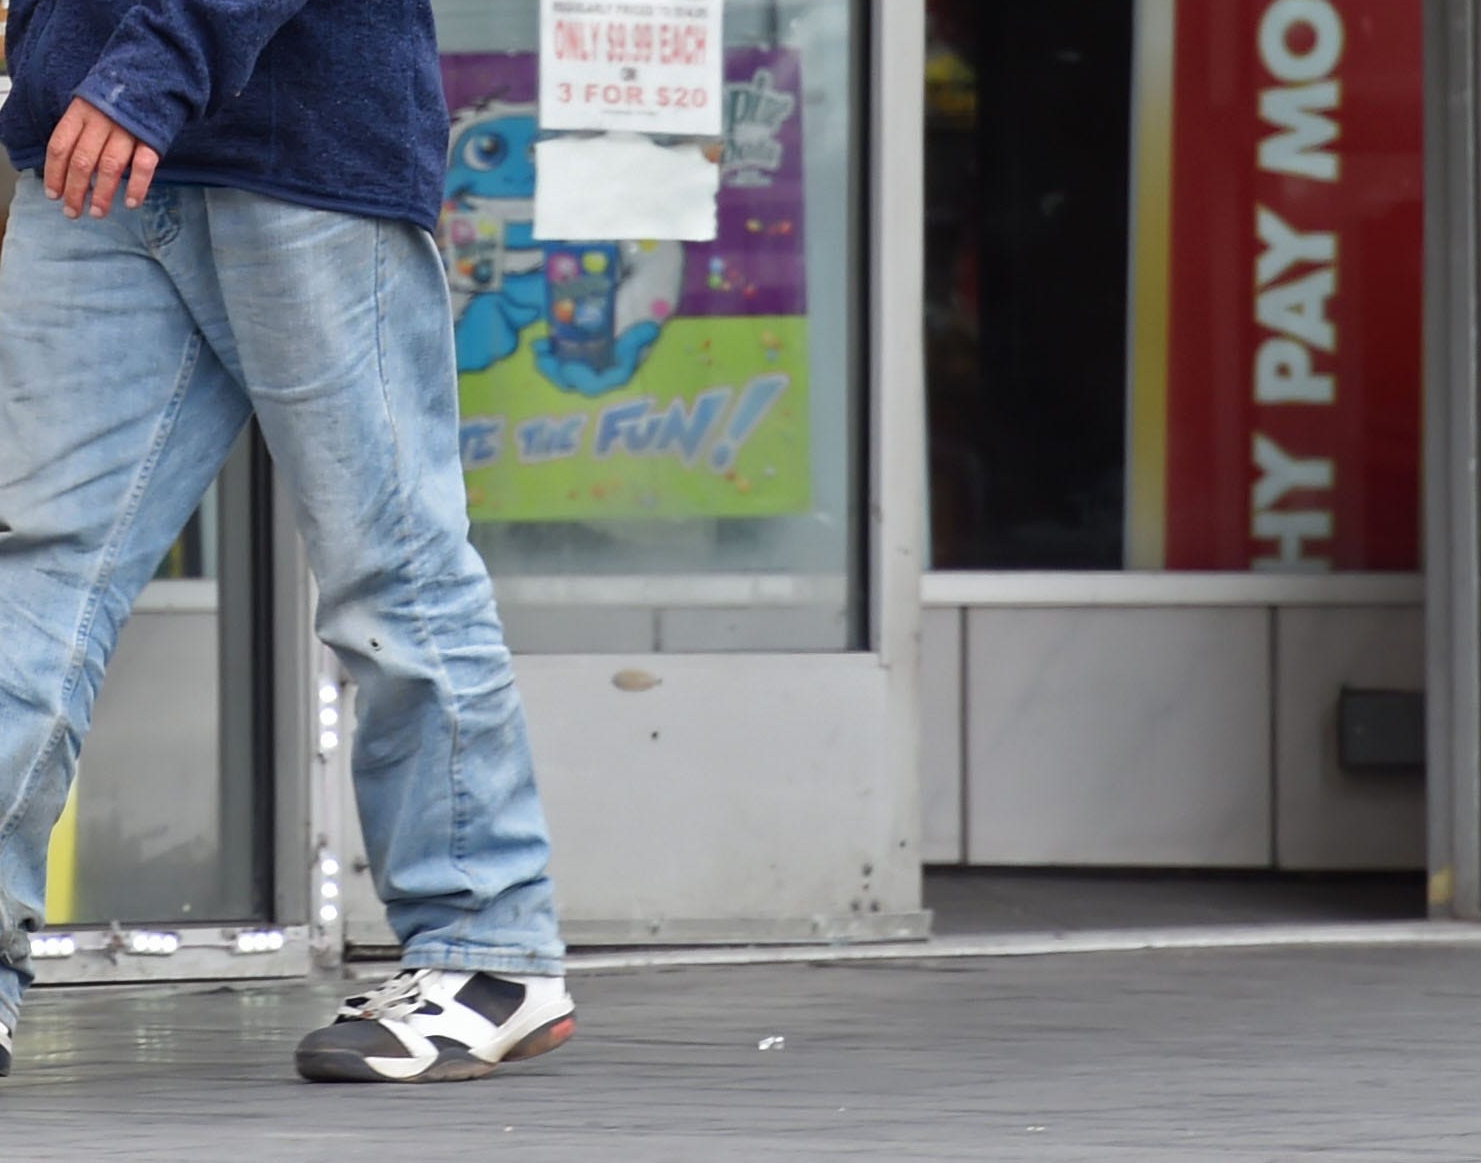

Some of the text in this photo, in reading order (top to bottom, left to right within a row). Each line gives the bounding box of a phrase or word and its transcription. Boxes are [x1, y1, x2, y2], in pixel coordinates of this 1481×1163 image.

[555, 20, 601, 61] ONLY
[659, 23, 708, 65] EACH
[557, 82, 708, 108] 3 FOR $20
[1253, 205, 1338, 404] PAY
